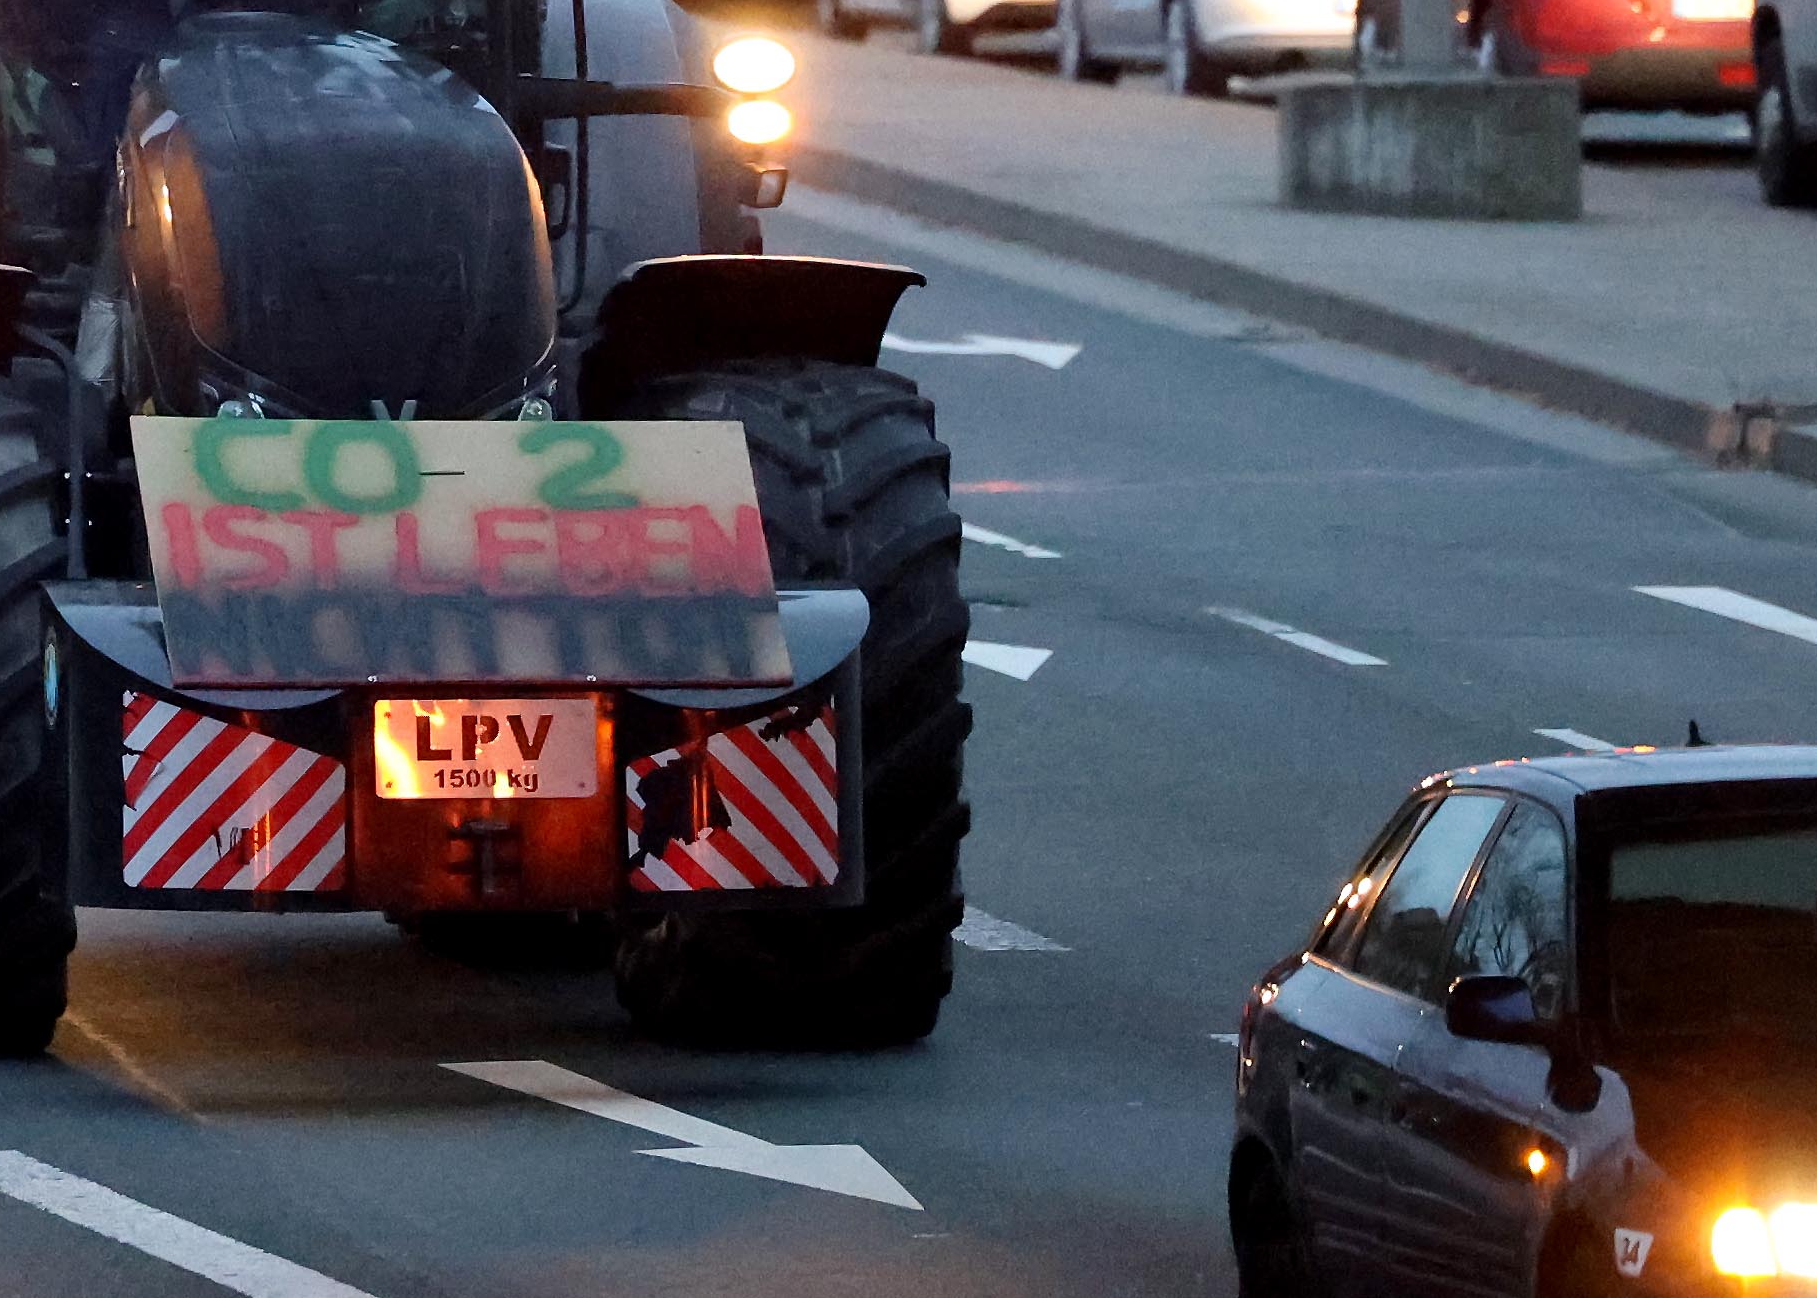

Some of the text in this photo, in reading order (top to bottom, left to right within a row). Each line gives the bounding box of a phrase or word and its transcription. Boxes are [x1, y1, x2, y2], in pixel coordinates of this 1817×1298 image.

[160, 500, 773, 597] IST LEBEN
[415, 714, 554, 761] LPV
[433, 768, 539, 793] 1500 kg
